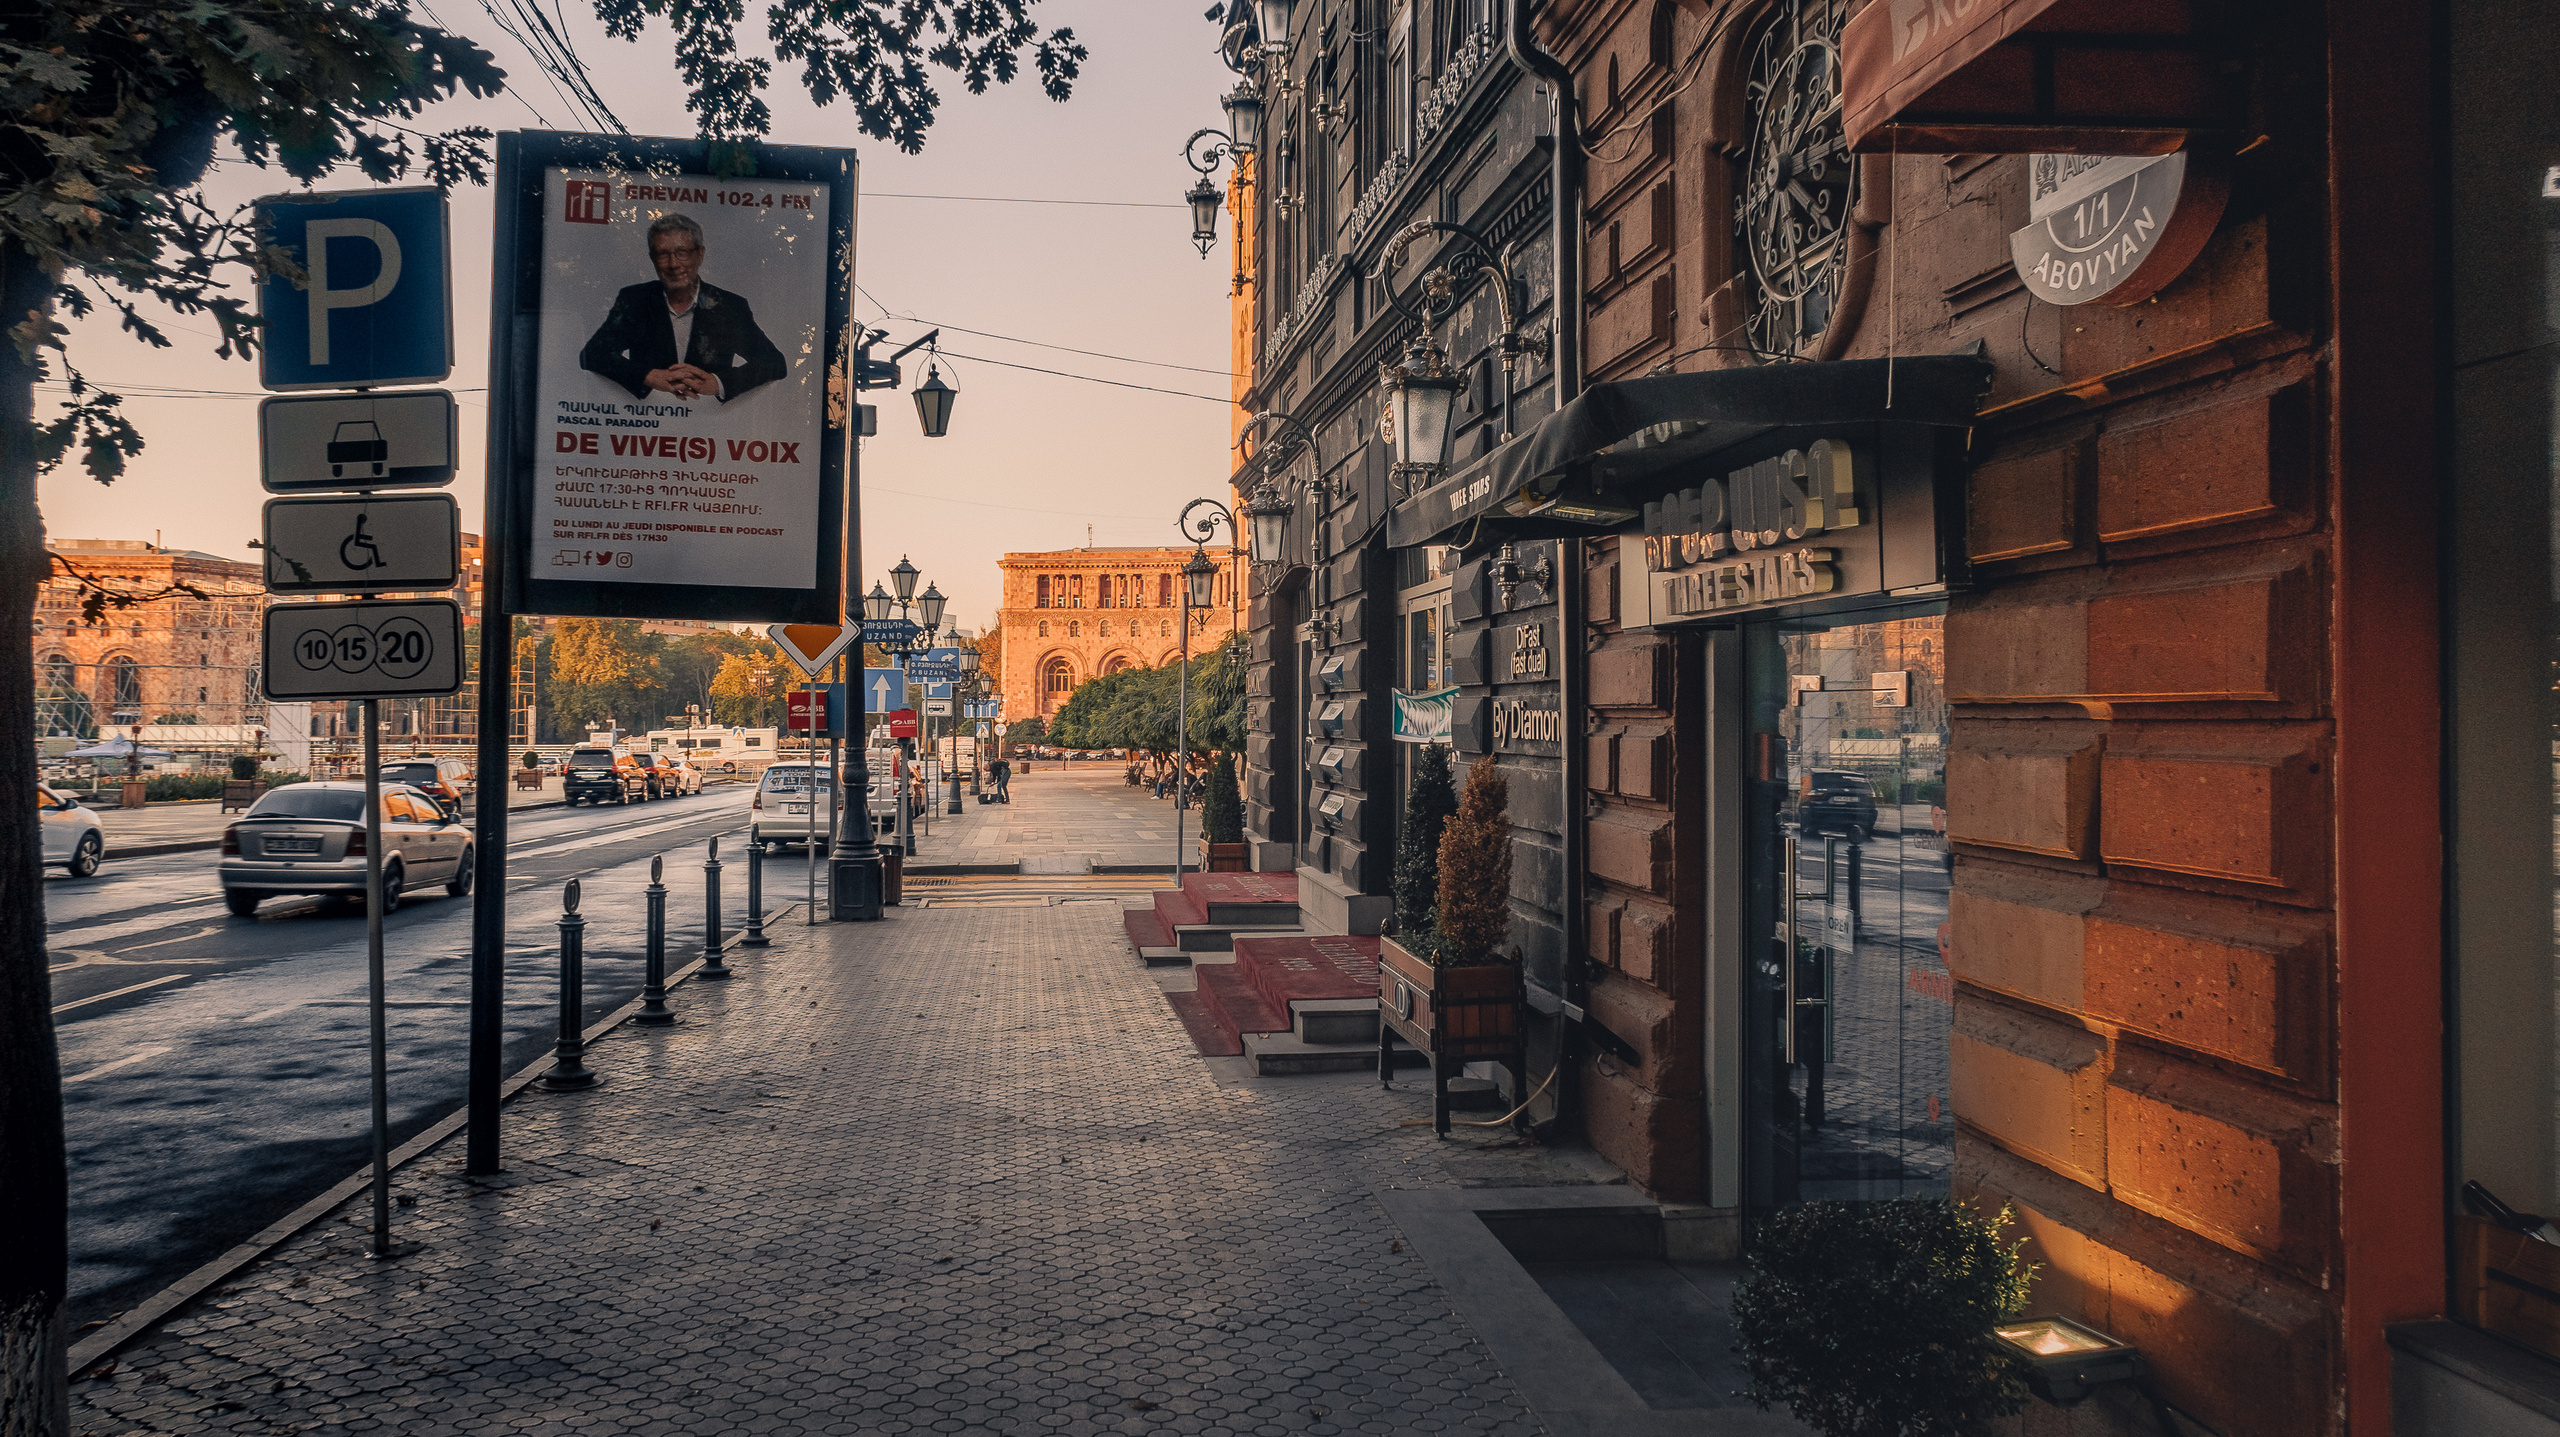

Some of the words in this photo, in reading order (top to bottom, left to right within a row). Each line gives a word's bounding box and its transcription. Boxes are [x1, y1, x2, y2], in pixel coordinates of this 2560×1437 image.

[568, 182, 606, 221] rfi
[625, 184, 708, 204] EREVAN
[717, 190, 773, 208] 102.4
[781, 193, 811, 210] FM
[2074, 192, 2109, 239] 1/1
[2032, 206, 2156, 292] ABOVYAN
[305, 217, 402, 365] P
[557, 400, 620, 415] ՊԱՍԿԱԼ
[623, 404, 693, 418] ՊԱՐԱԴՈՒ
[557, 415, 602, 426] PASCAL
[605, 418, 660, 428] PARADOU
[555, 431, 600, 455] DE
[610, 434, 716, 464] VIVE(S)
[727, 438, 801, 464] VOIX
[554, 482, 595, 493] ԺԱՄԸ
[644, 500, 688, 512] RFI.FR
[553, 519, 568, 528] DU
[571, 520, 603, 529] LUNDI
[606, 521, 620, 530] AU
[622, 521, 652, 531] JEUDI
[655, 523, 716, 533] DISPONIBLE
[719, 526, 733, 534] EN
[736, 526, 784, 536] PODCAST
[553, 530, 574, 539] SUR
[577, 531, 610, 540] RFI.FR
[612, 531, 633, 541] DÈS
[636, 533, 668, 543] 17H30
[1663, 566, 1726, 616] THREE
[1736, 548, 1824, 605] STARS
[863, 621, 903, 630] ՅՈՒԶԱՆԴԻ
[866, 632, 903, 640] UZAND
[1516, 624, 1541, 650] DiFast
[302, 638, 327, 661] 10
[336, 636, 367, 661] 15
[382, 631, 425, 664] 20
[1510, 652, 1527, 680] (fast
[1527, 647, 1546, 678] dual)
[1493, 701, 1508, 748] By
[1511, 700, 1562, 742] Diamon
[1828, 916, 1849, 934] OPEN
